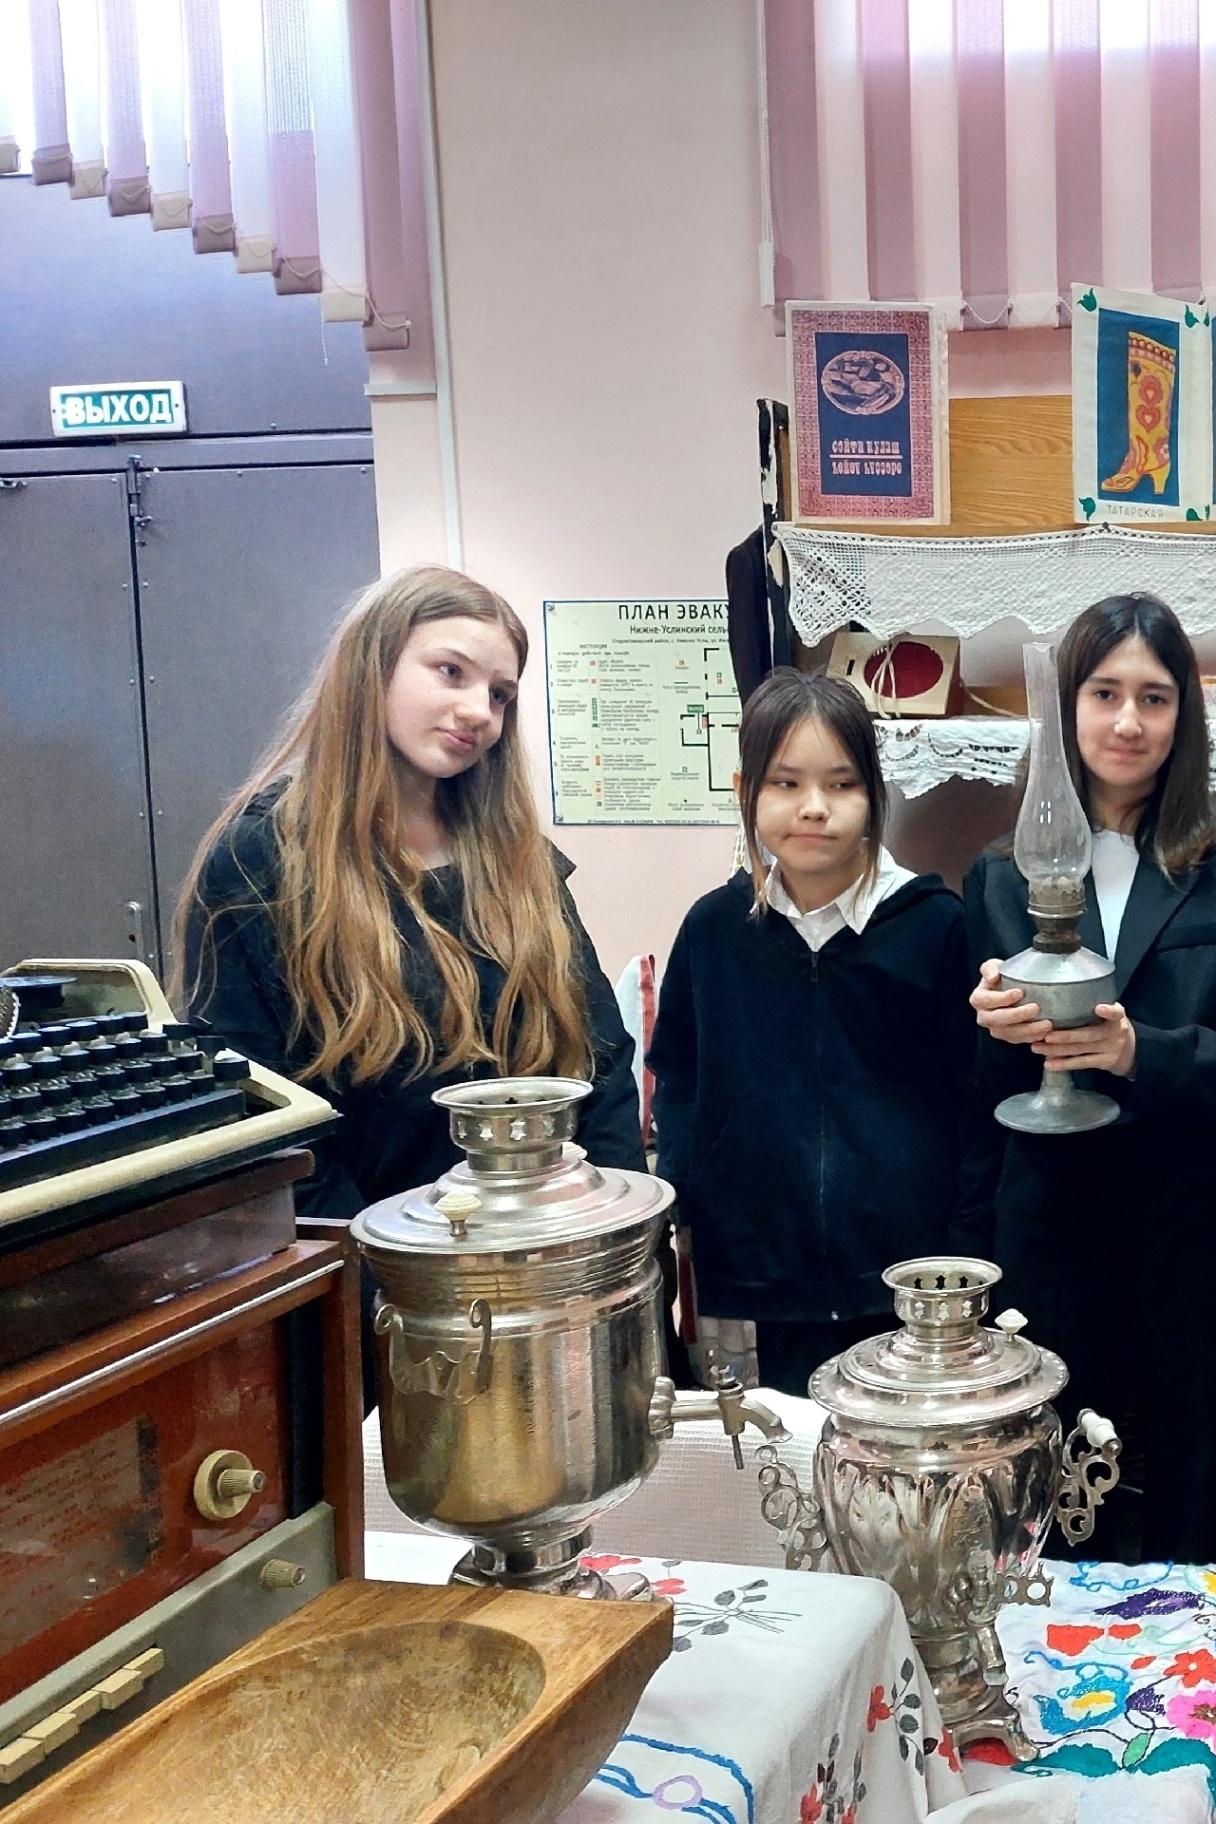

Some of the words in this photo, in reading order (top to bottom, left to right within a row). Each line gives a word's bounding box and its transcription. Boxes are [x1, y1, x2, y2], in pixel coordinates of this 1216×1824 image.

[65, 393, 172, 425] ВЫХОД
[618, 604, 669, 620] ПЛАН
[629, 624, 706, 635] Нижне-Услинский
[707, 626, 728, 635] сель
